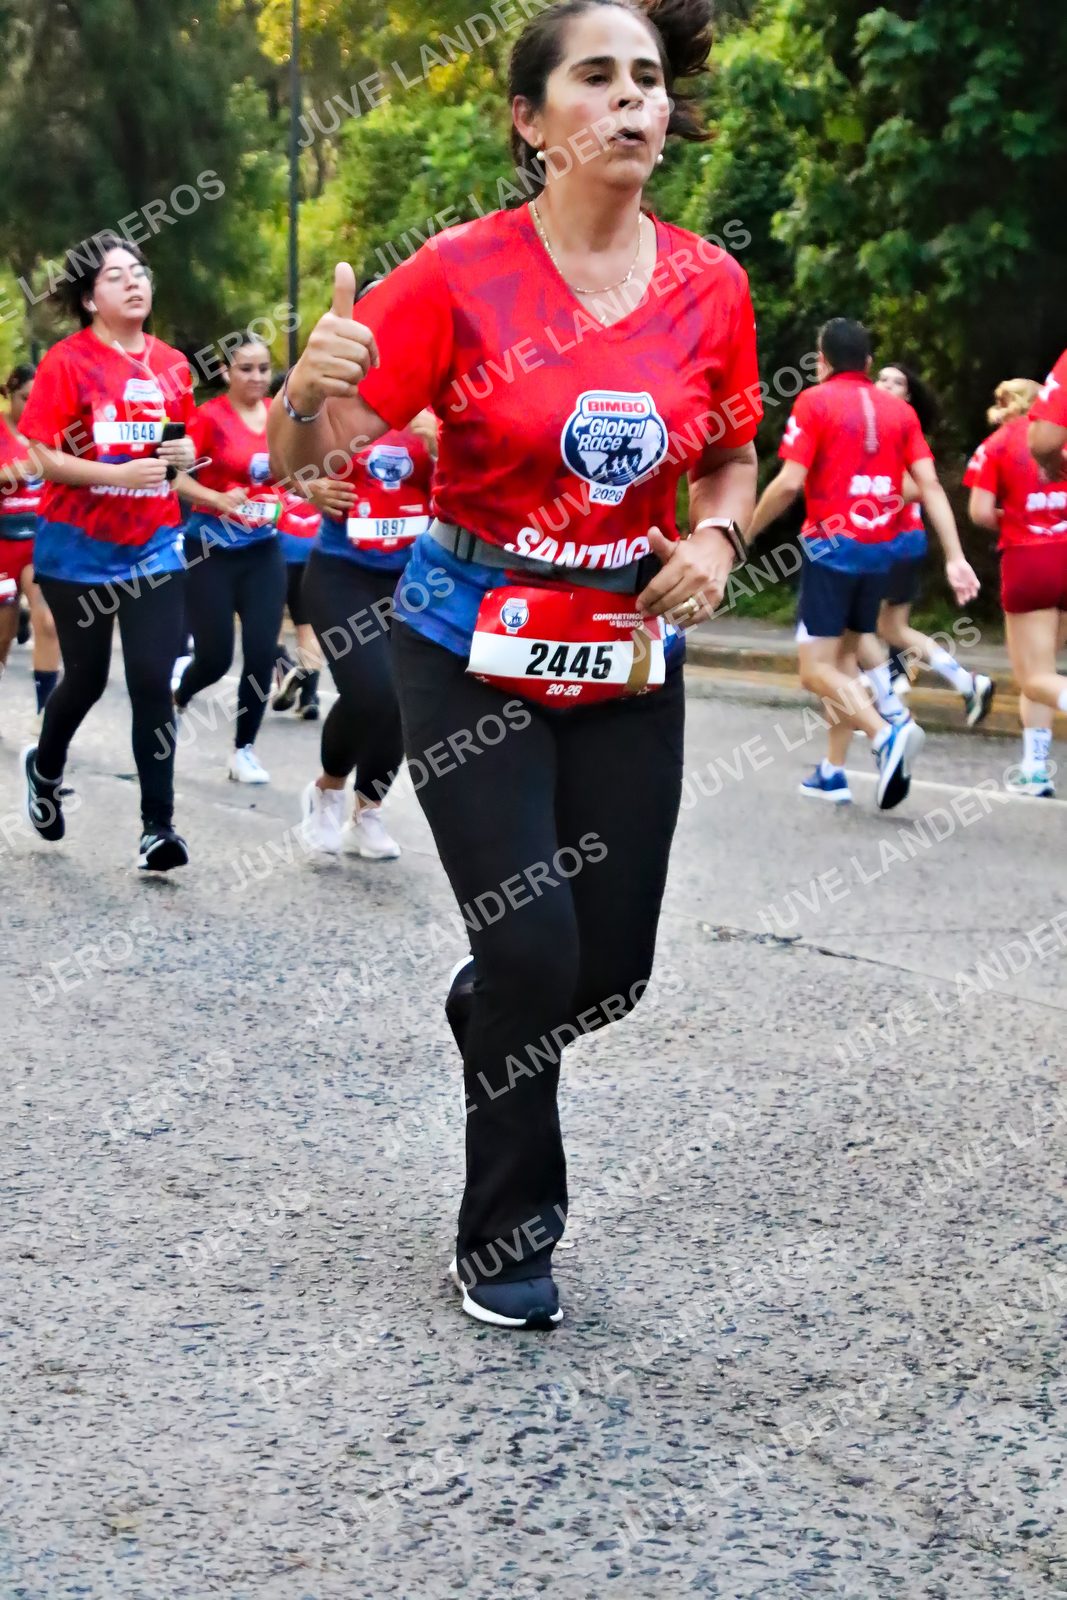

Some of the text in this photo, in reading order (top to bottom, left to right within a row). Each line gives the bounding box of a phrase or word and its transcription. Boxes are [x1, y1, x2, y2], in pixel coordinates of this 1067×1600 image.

[587, 401, 645, 413] BIMBO
[119, 423, 155, 440] 17648
[589, 418, 645, 438] Global
[577, 433, 623, 451] Race
[592, 487, 623, 502] 2026
[376, 519, 406, 536] 1897
[504, 527, 651, 569] SANTIAG
[592, 612, 643, 621] COMPARTIMO
[525, 642, 613, 680] 2445
